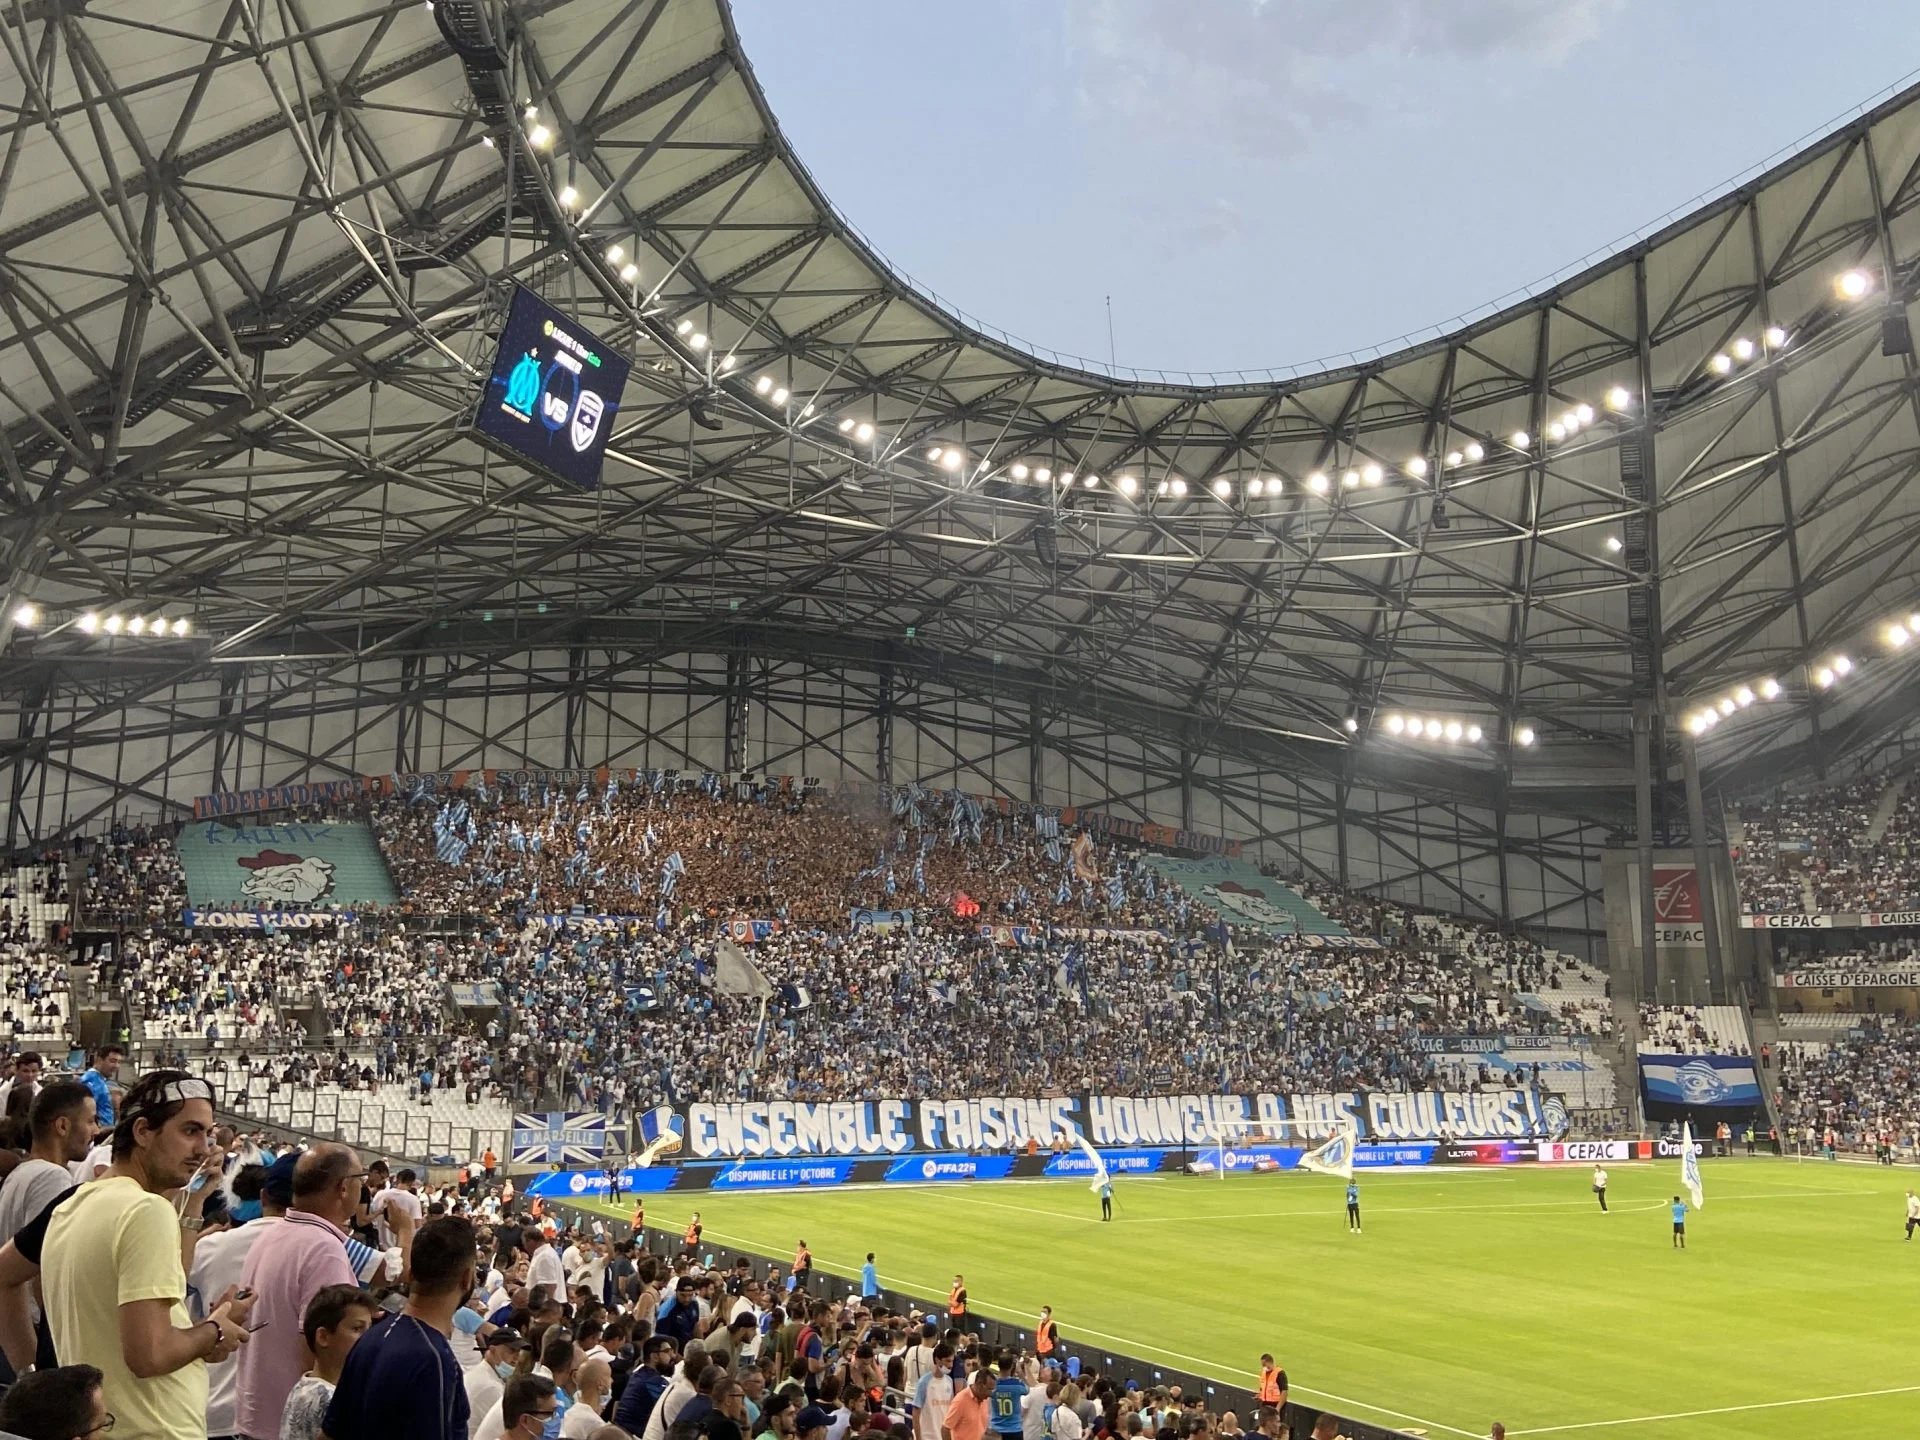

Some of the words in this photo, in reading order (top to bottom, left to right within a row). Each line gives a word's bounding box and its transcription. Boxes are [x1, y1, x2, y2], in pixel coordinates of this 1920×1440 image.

[544, 391, 568, 423] VS
[496, 768, 597, 787] SOUTH
[200, 779, 364, 815] INDEPENDANCE
[1077, 808, 1144, 836] KAOTIC
[1174, 830, 1238, 854] GROUP
[192, 912, 260, 928] ZONE
[261, 912, 340, 928] KAOT
[1769, 915, 1822, 927] CEPAC
[1655, 930, 1704, 942] CEPAC
[1795, 974, 1836, 987] CAISSE
[1840, 973, 1918, 986] D'EPARGNE
[690, 1100, 911, 1158] ENSEMBLE
[919, 1096, 1080, 1149] FAISONS
[1090, 1095, 1249, 1144] HONNEUR
[1292, 1092, 1360, 1139] NOS
[533, 1130, 595, 1144] MARSEILLE
[1378, 1151, 1385, 1161] LE
[1394, 1150, 1422, 1161] OCTOBRE
[1568, 1142, 1614, 1160] CEPAC
[1658, 1139, 1703, 1156] Orae
[1057, 1159, 1097, 1170] DISPONIBL
[1118, 1157, 1149, 1168] OCTOBRE
[728, 1169, 776, 1182] DISPONIBLE
[778, 1169, 787, 1180] LE
[800, 1167, 836, 1179] OCTOBRE
[997, 1398, 1014, 1417] 10
